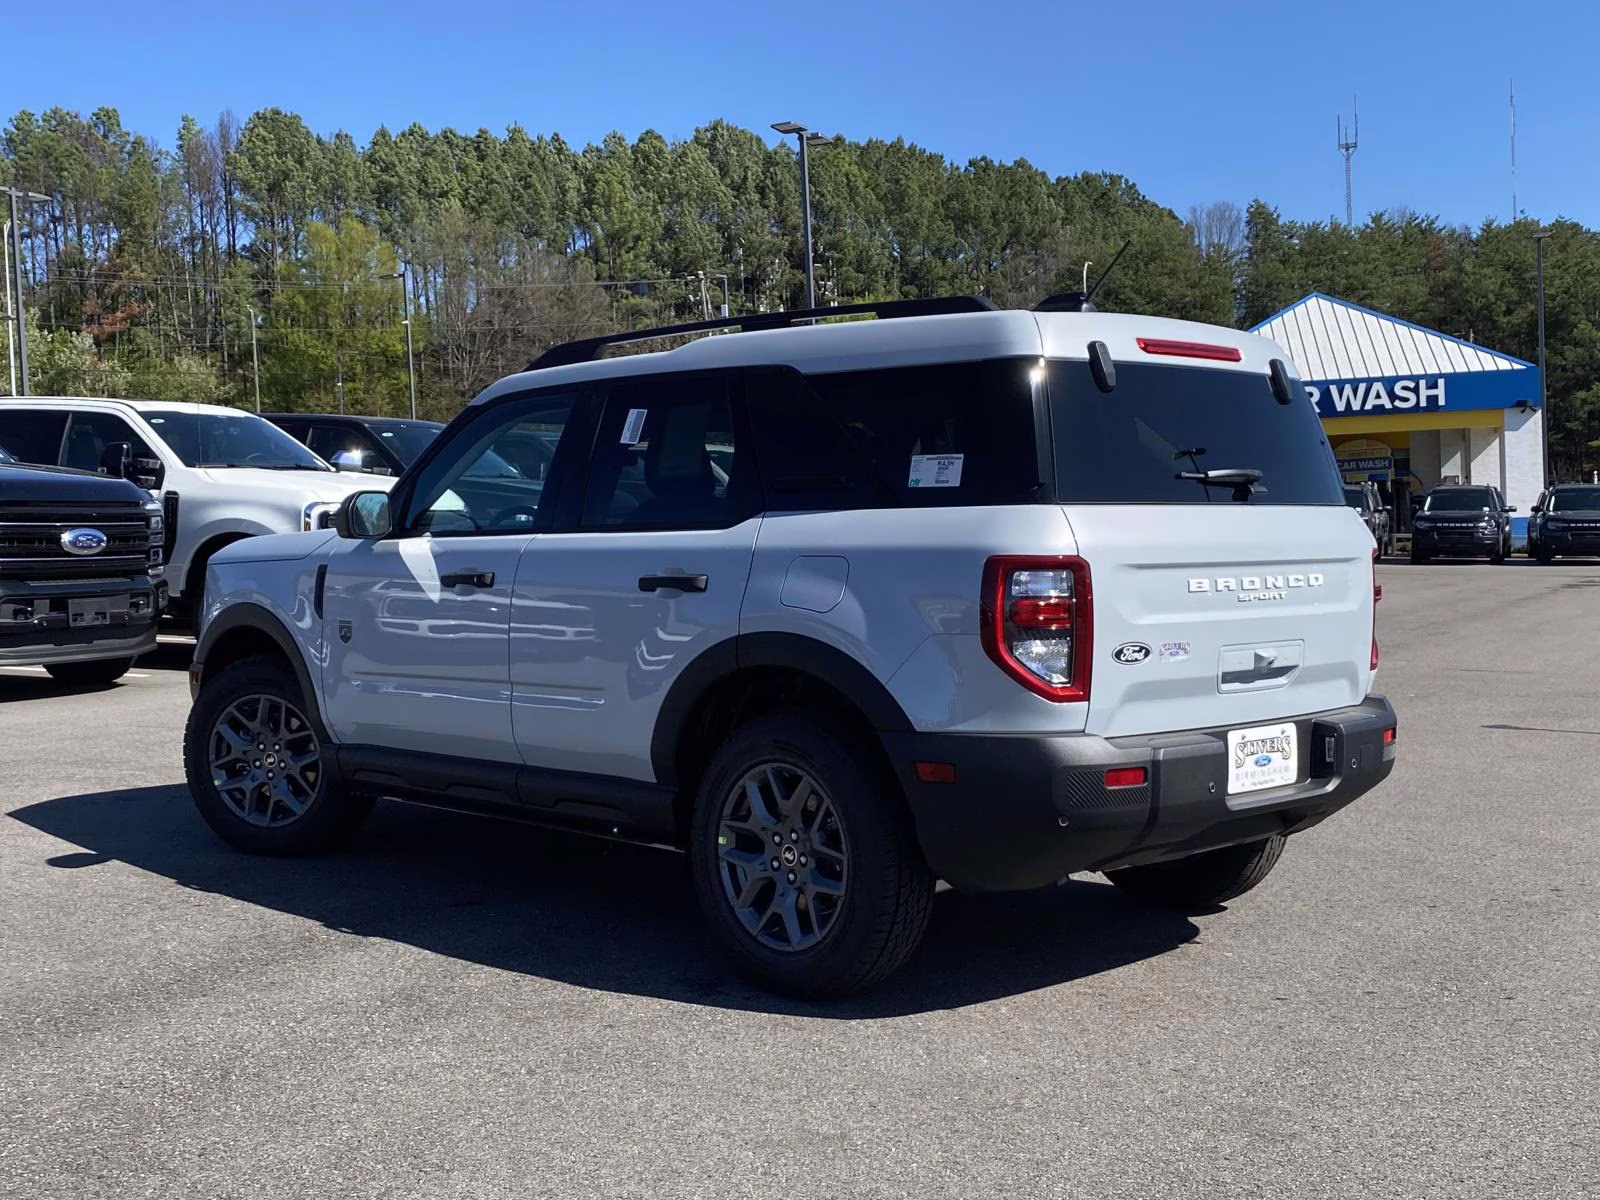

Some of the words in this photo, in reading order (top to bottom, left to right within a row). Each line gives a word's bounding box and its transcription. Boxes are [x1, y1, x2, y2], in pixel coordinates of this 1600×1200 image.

[1329, 378, 1446, 412] WASH
[1359, 459, 1389, 469] WASH
[1187, 573, 1325, 593] BRONCO
[1237, 590, 1288, 603] SPORT
[1235, 735, 1292, 769] STIVERS
[1235, 764, 1290, 782] BIRMINGHAM
